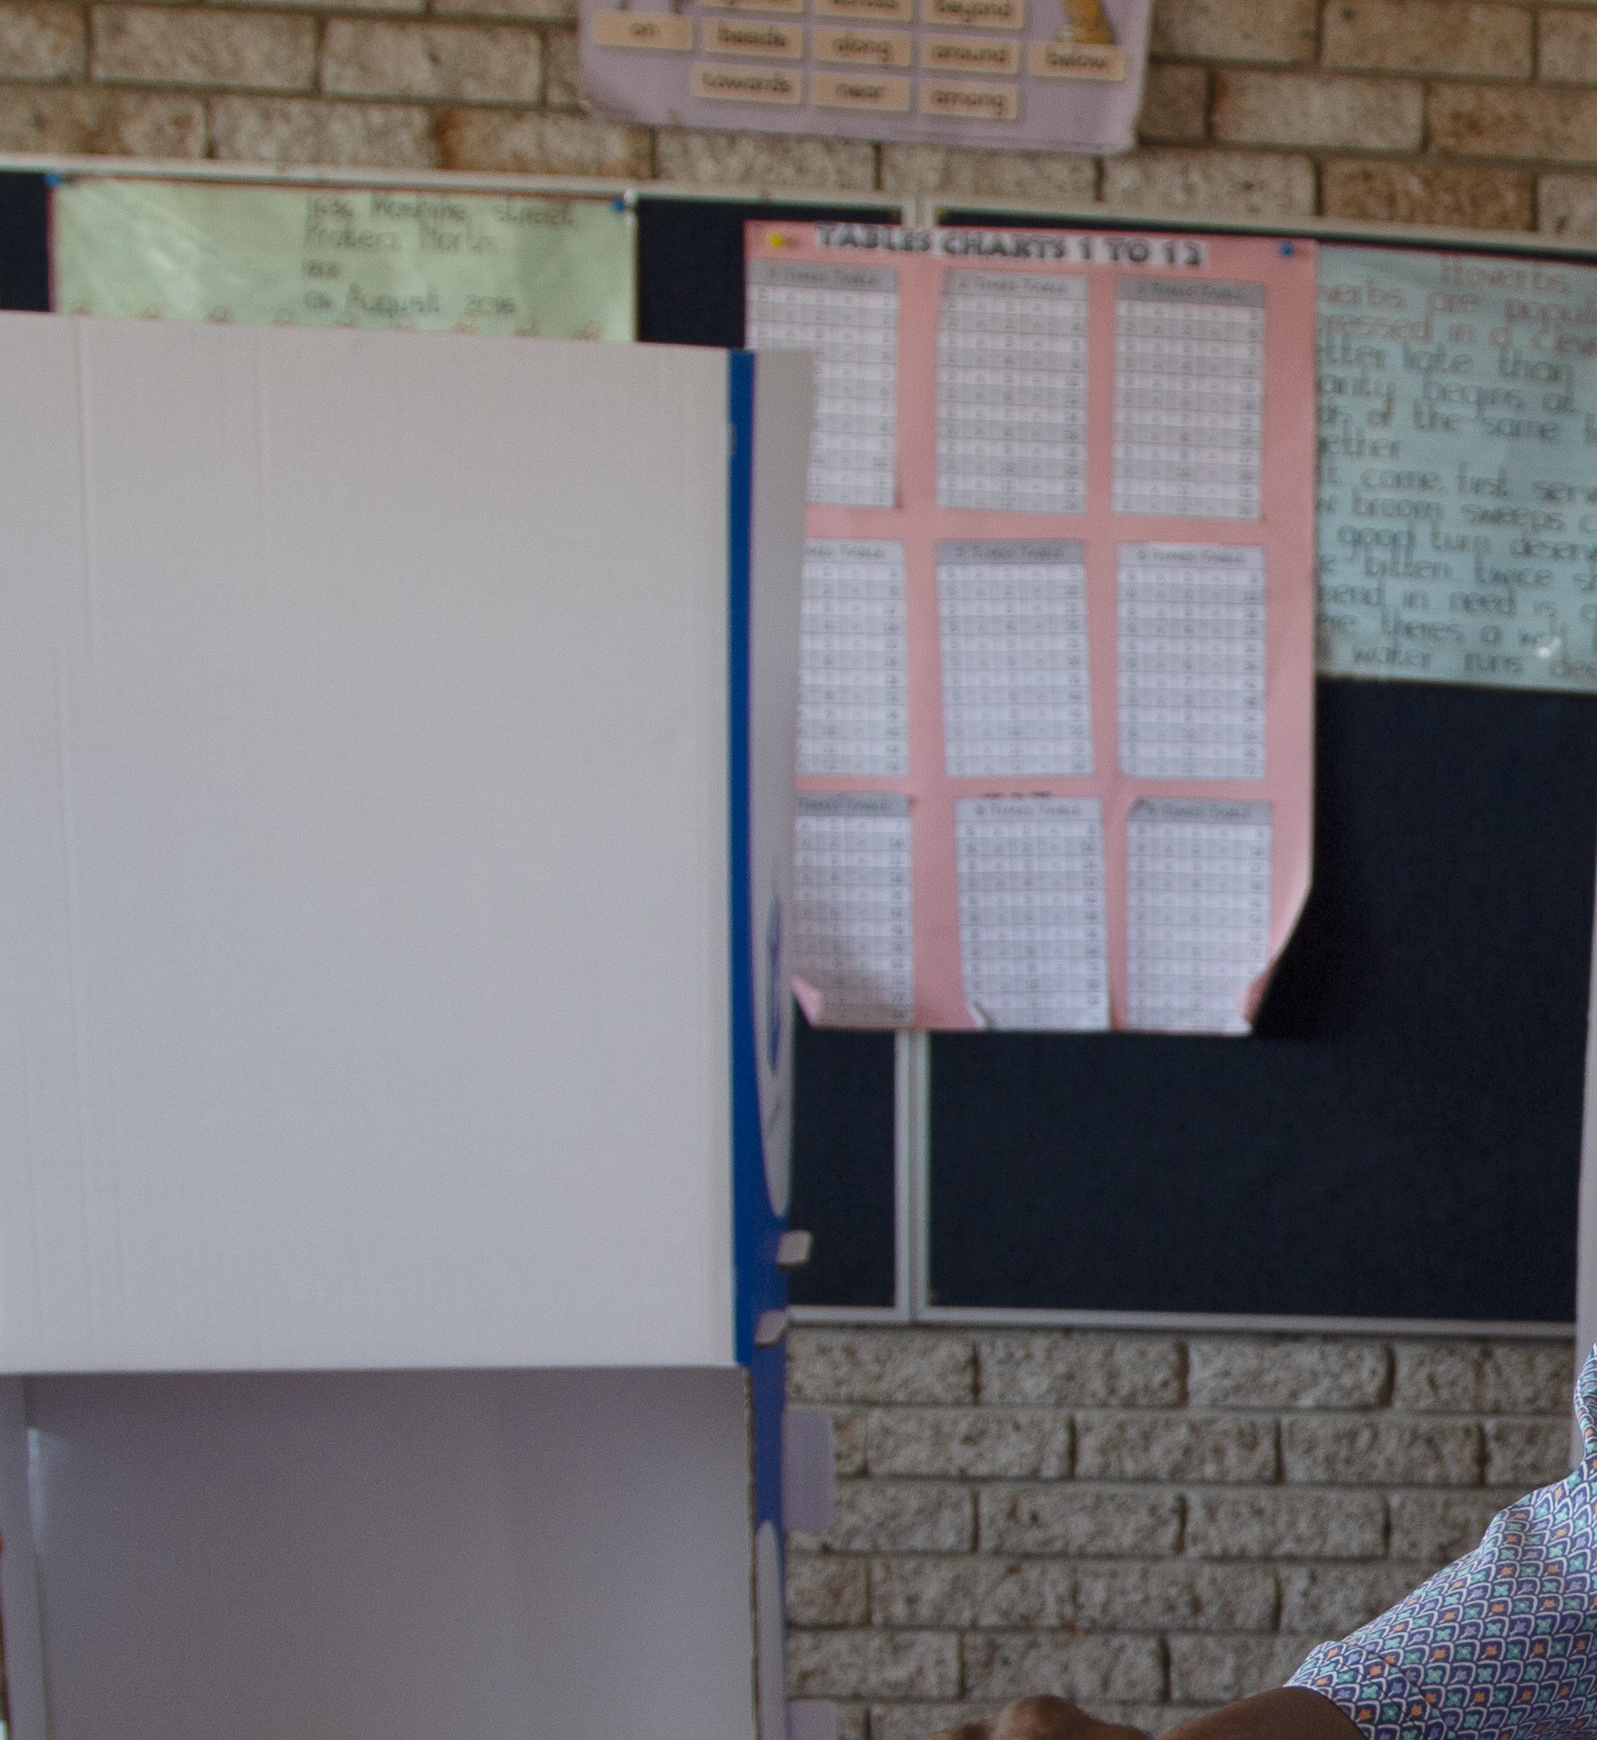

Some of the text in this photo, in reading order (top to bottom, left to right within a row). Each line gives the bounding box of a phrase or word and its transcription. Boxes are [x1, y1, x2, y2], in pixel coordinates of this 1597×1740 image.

[717, 20, 788, 47] beside
[831, 31, 893, 63] along
[931, 42, 1010, 63] around
[1046, 45, 1110, 69] below
[701, 71, 792, 94] towards
[835, 82, 884, 98] near
[931, 89, 1007, 116] among
[816, 223, 1203, 267] TABLES CHARTS 1 TO 12
[1317, 280, 1406, 310] verbs
[1318, 311, 1432, 344] pressed
